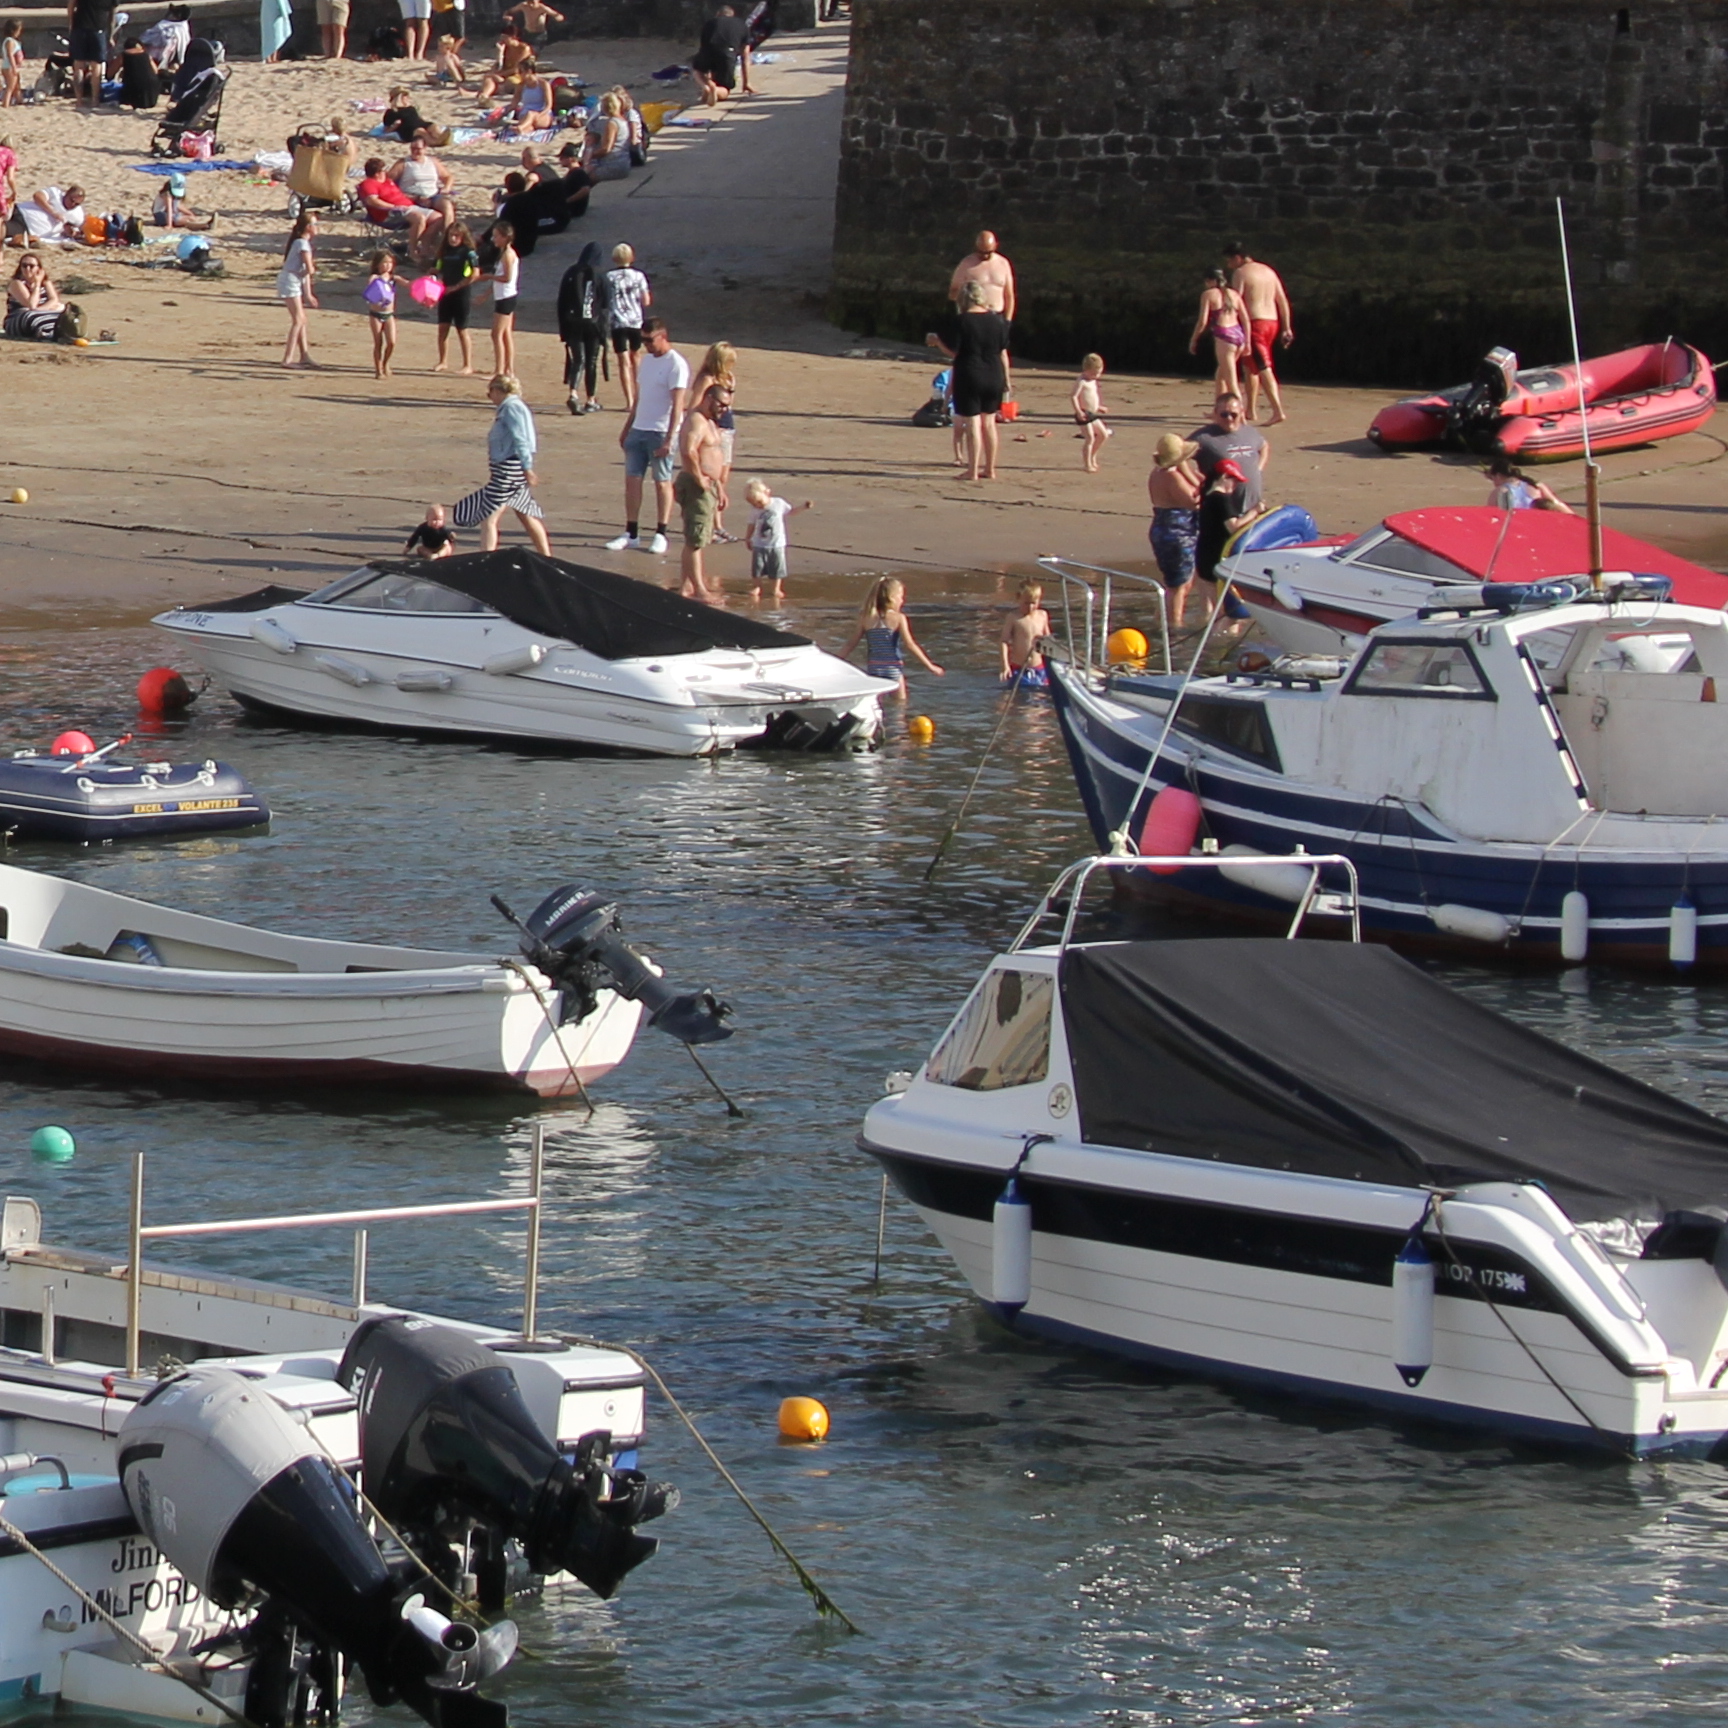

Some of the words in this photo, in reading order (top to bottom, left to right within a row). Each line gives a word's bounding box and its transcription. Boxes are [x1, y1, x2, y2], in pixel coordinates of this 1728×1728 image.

[133, 803, 163, 813] EXCEL
[178, 799, 222, 811] VOLANTE
[1480, 1269, 1505, 1288] 175
